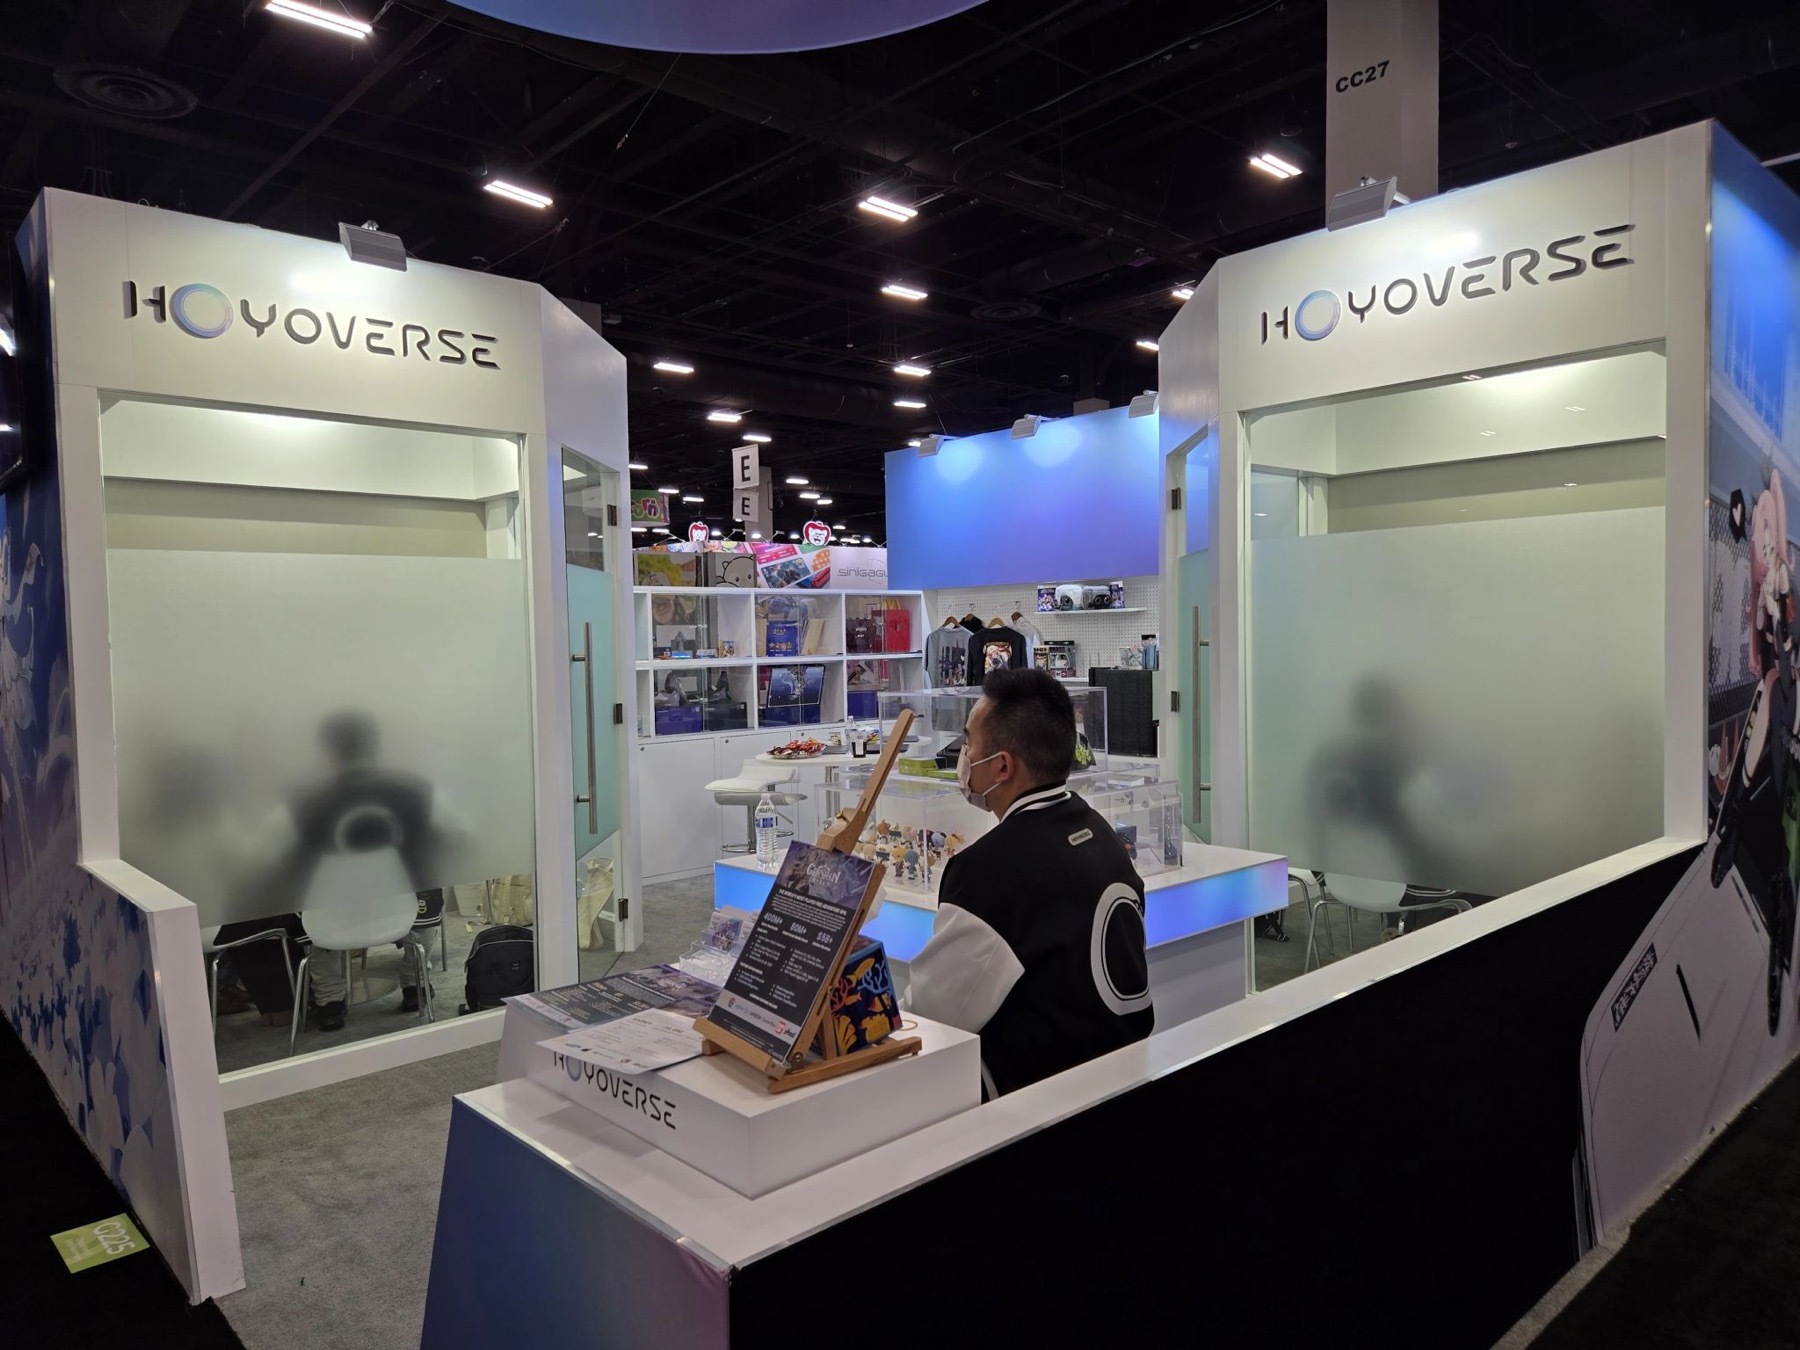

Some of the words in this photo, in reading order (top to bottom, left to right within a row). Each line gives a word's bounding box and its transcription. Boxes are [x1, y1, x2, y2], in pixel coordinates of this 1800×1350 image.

[1335, 59, 1390, 94] CC27
[1261, 223, 1637, 345] HOYOVERSE
[123, 279, 501, 370] HOYOVERSE
[741, 455, 751, 482] E
[741, 496, 750, 516] E
